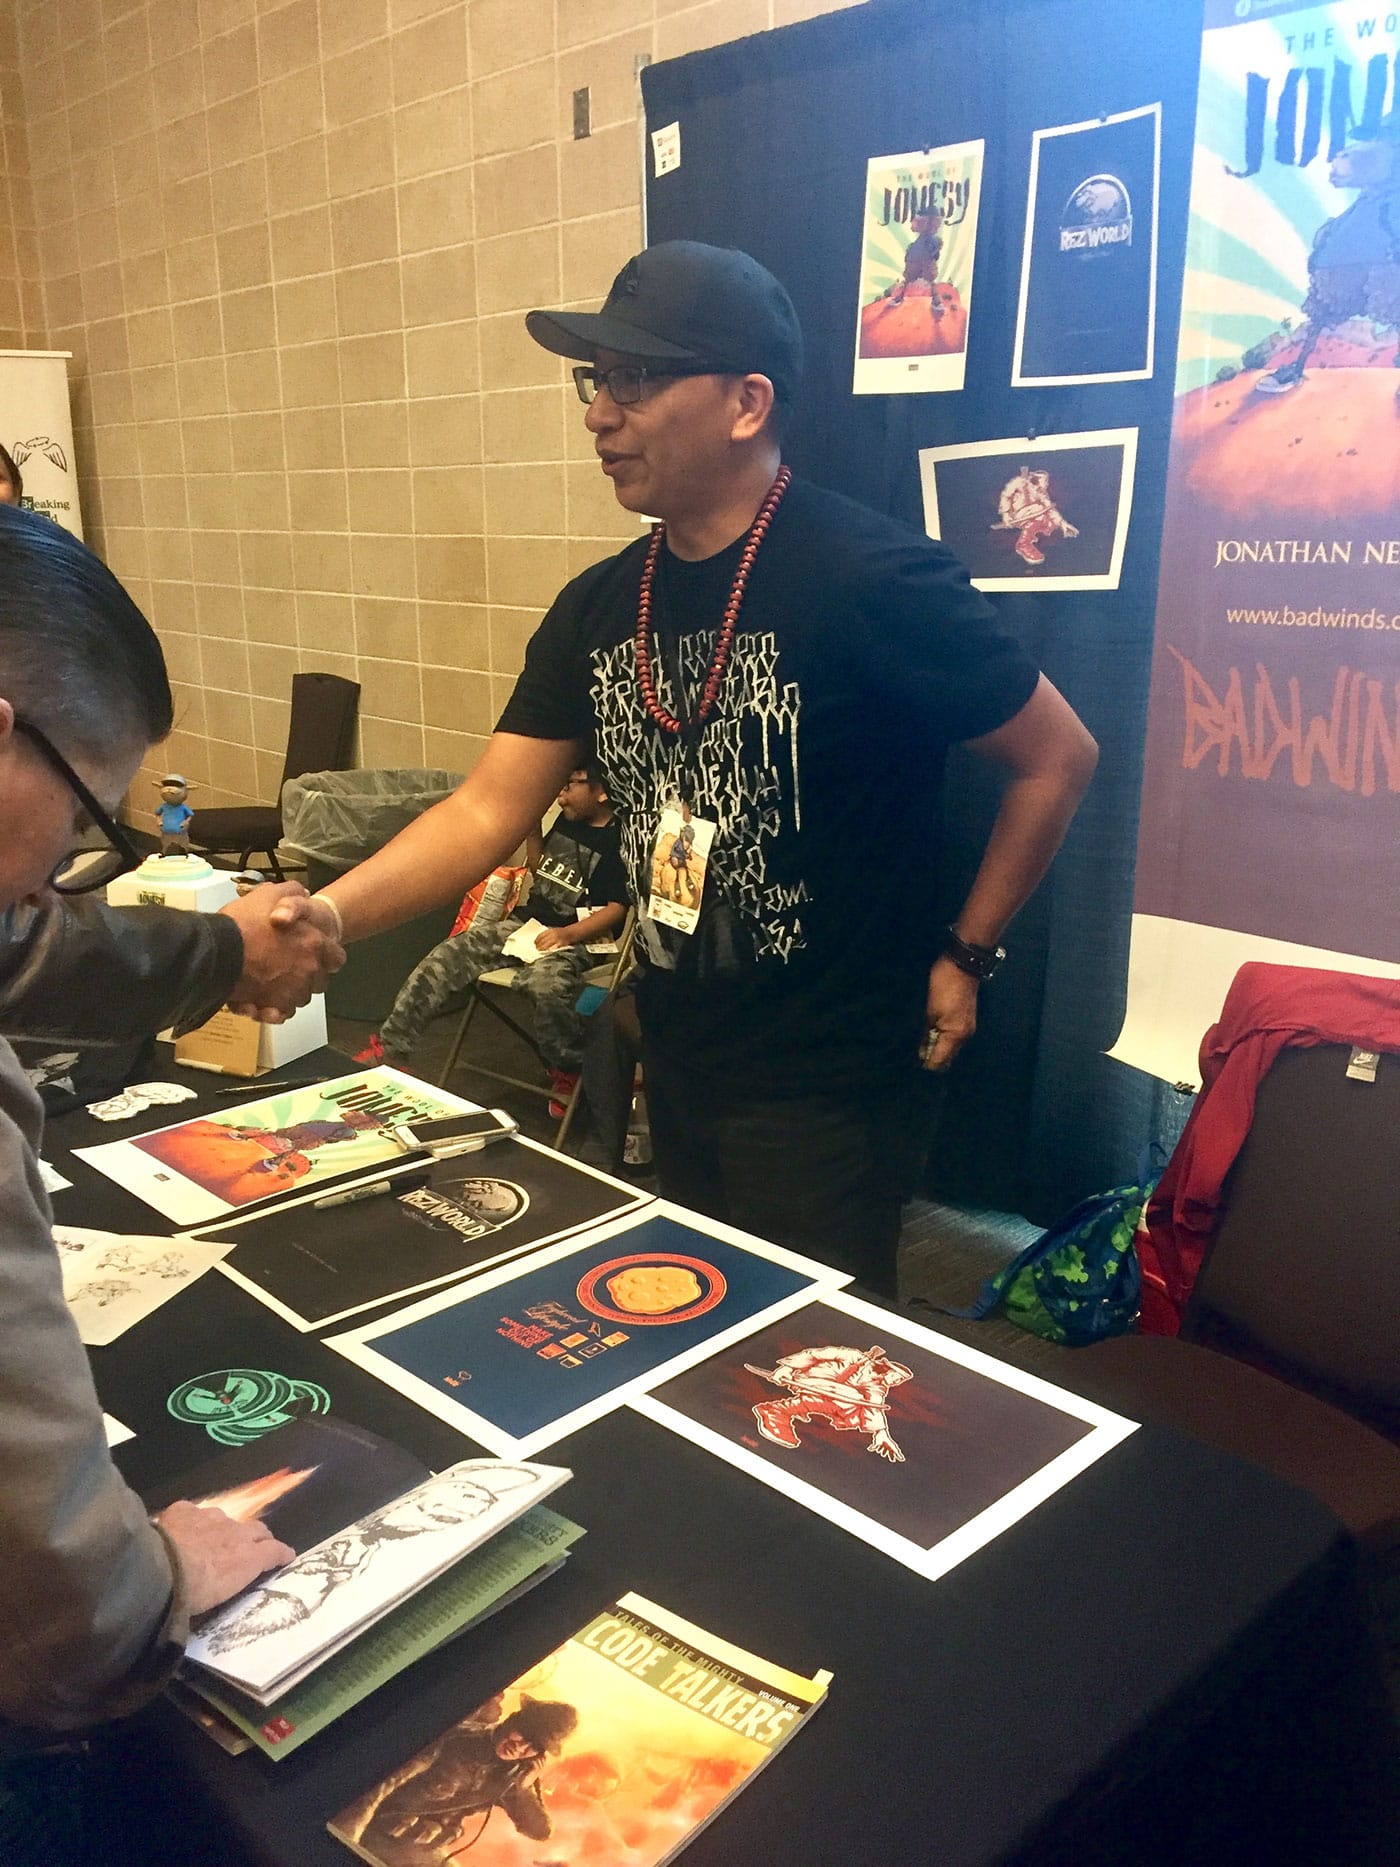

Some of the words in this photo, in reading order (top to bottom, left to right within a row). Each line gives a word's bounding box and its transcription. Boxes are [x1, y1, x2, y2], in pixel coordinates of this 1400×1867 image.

[1285, 28, 1334, 54] THE
[1224, 50, 1400, 178] JON
[1060, 229, 1087, 251] REZ
[1087, 223, 1130, 248] WORLD
[21, 499, 71, 511] Breaking
[1214, 540, 1353, 568] JONATHAN
[1363, 541, 1400, 564] NE
[537, 854, 583, 890] EBEL
[396, 1189, 441, 1211] REZ
[426, 1201, 487, 1236] WORLD
[615, 1611, 650, 1634] TALES
[652, 1632, 669, 1646] OF
[673, 1643, 696, 1660] THE
[695, 1657, 745, 1684] MIGHTY
[583, 1619, 668, 1677] CODE
[659, 1662, 794, 1744] TALKERS
[758, 1689, 786, 1708] VOLUME
[785, 1701, 801, 1713] ONE
